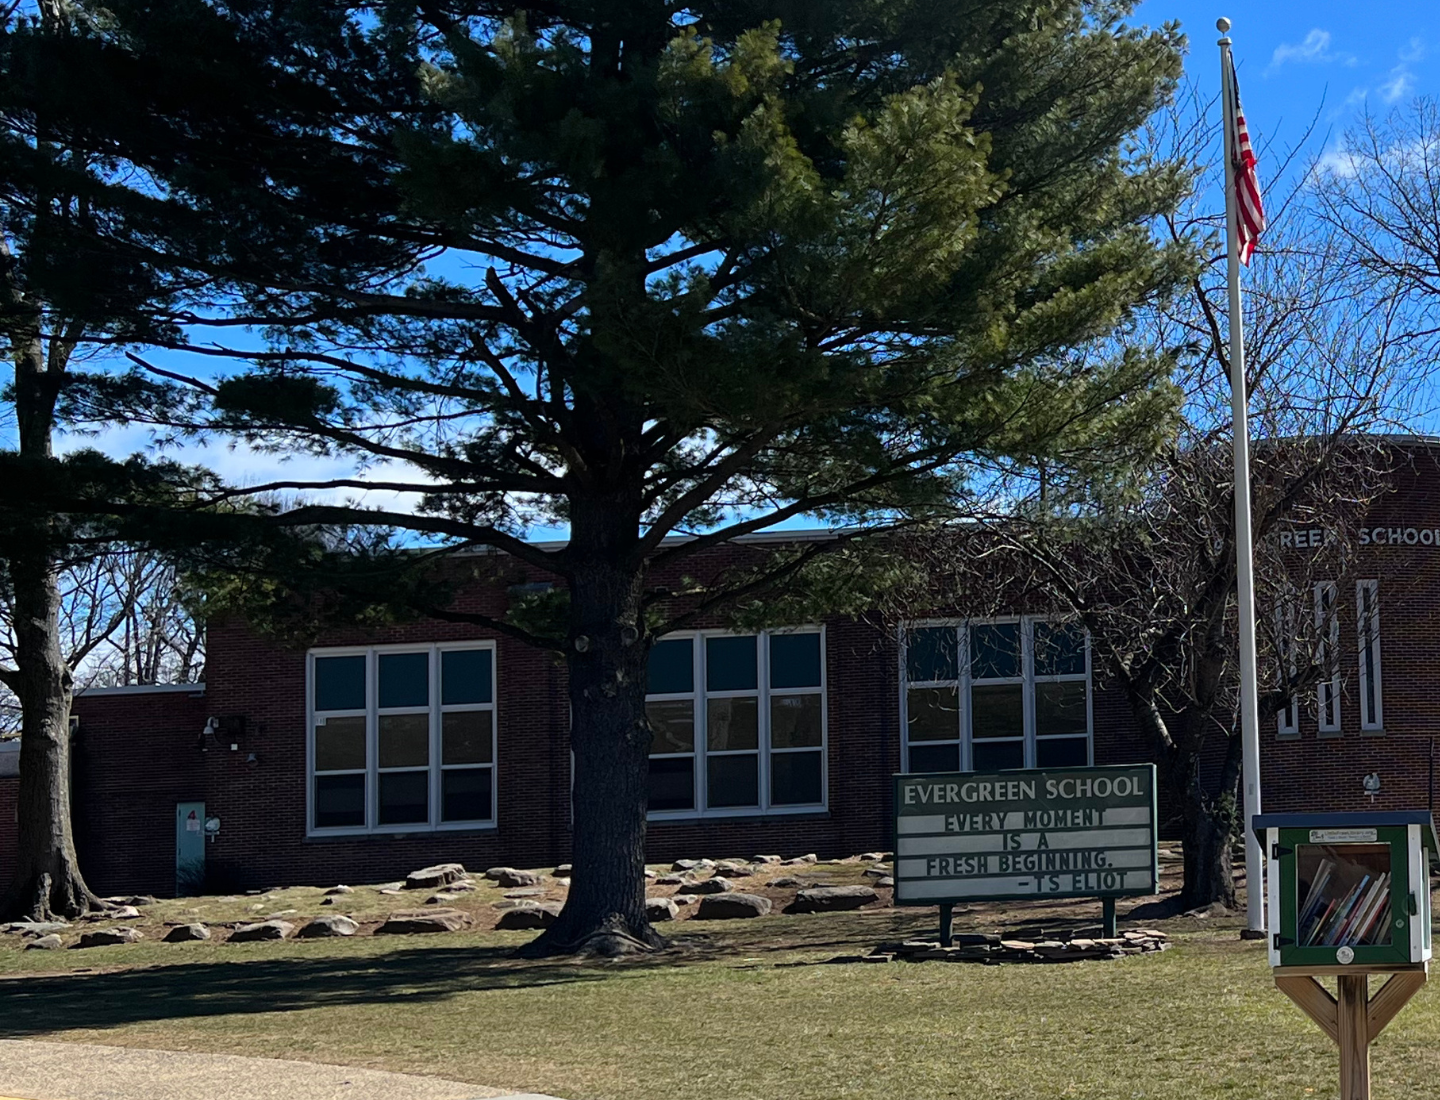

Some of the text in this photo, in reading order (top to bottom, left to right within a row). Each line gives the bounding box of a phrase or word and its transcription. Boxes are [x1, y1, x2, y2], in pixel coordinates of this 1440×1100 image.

[904, 777, 1143, 804] EVERGREEN SCHOOL
[945, 808, 1106, 832] EVERY MOMENT
[1002, 831, 1049, 850] IS A
[926, 851, 1113, 876] FRESH BEGINNING.
[1072, 872, 1127, 891] ELIOT
